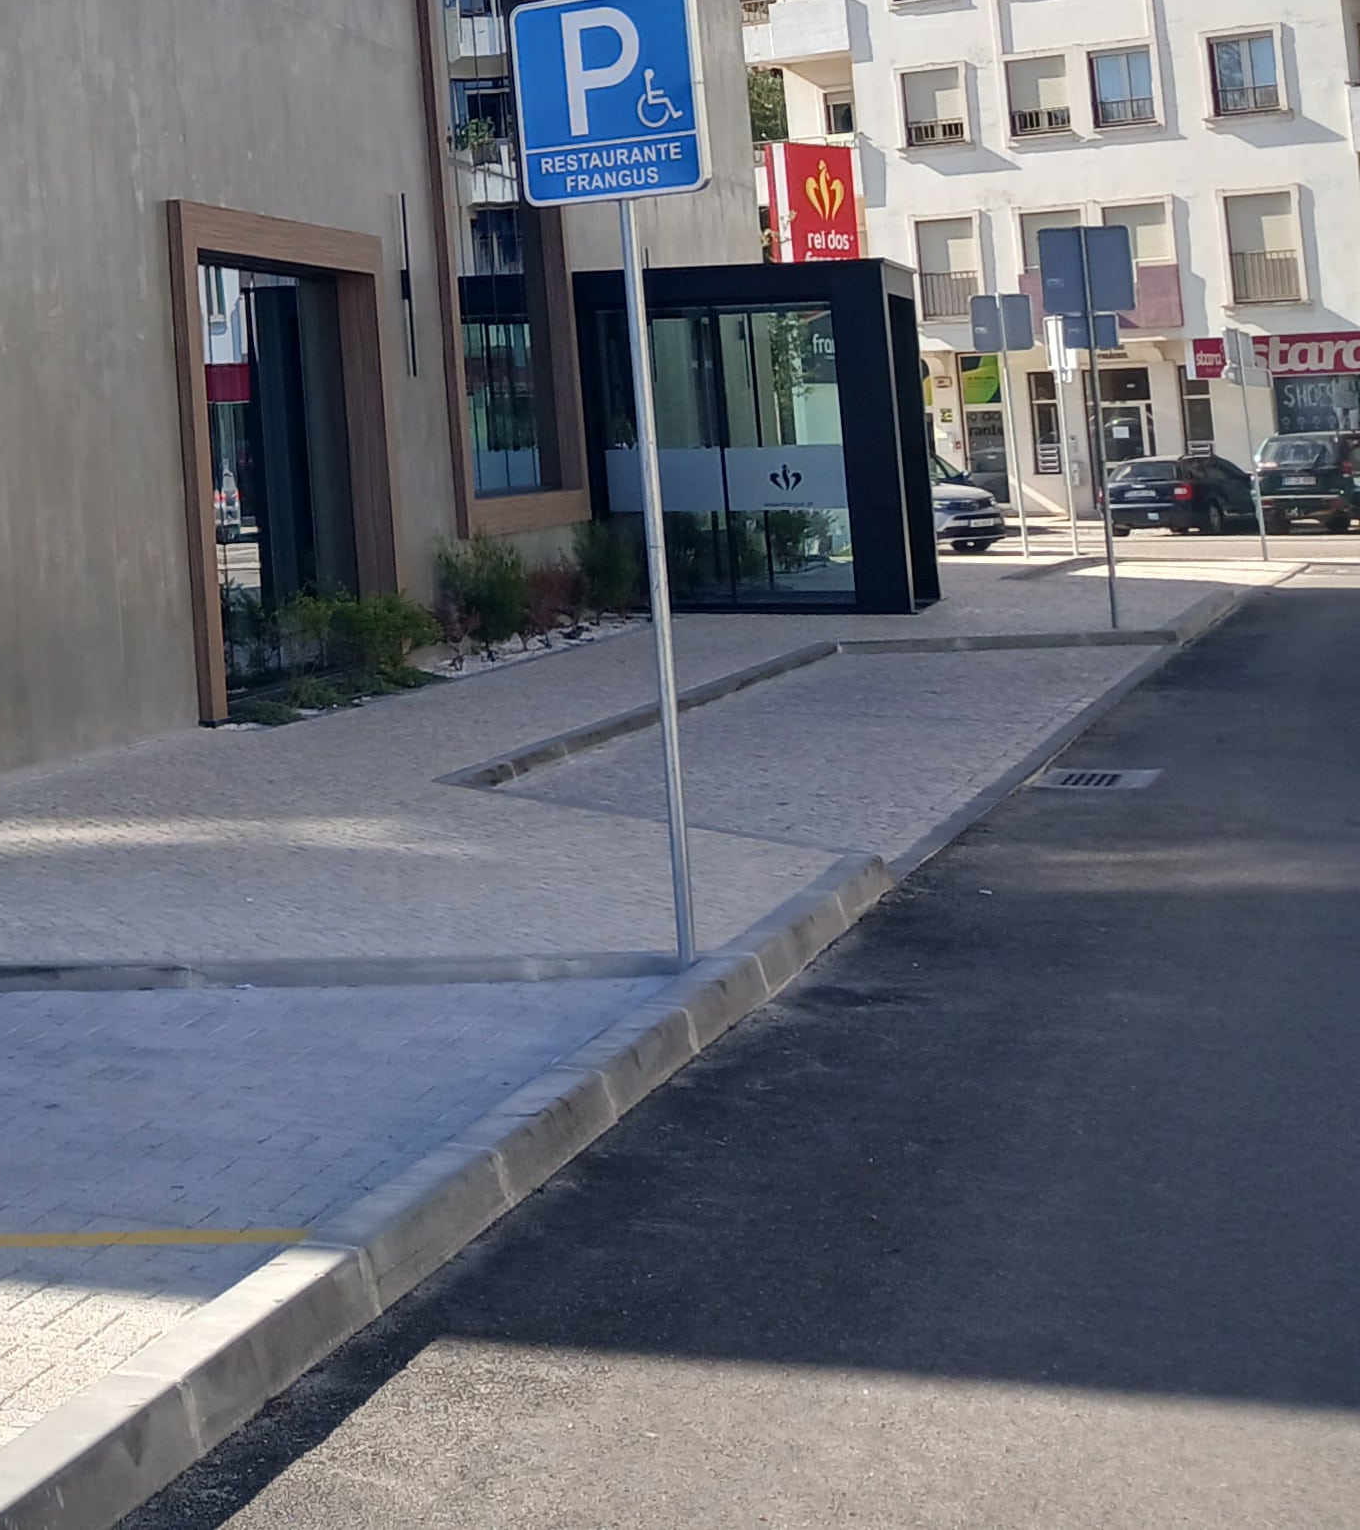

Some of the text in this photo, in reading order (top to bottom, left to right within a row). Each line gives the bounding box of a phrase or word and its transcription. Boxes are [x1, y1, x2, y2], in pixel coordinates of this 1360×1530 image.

[560, 6, 640, 137] P
[541, 141, 682, 175] RESTAURANTE
[565, 167, 660, 193] FRANGUS
[807, 230, 850, 250] rei dos
